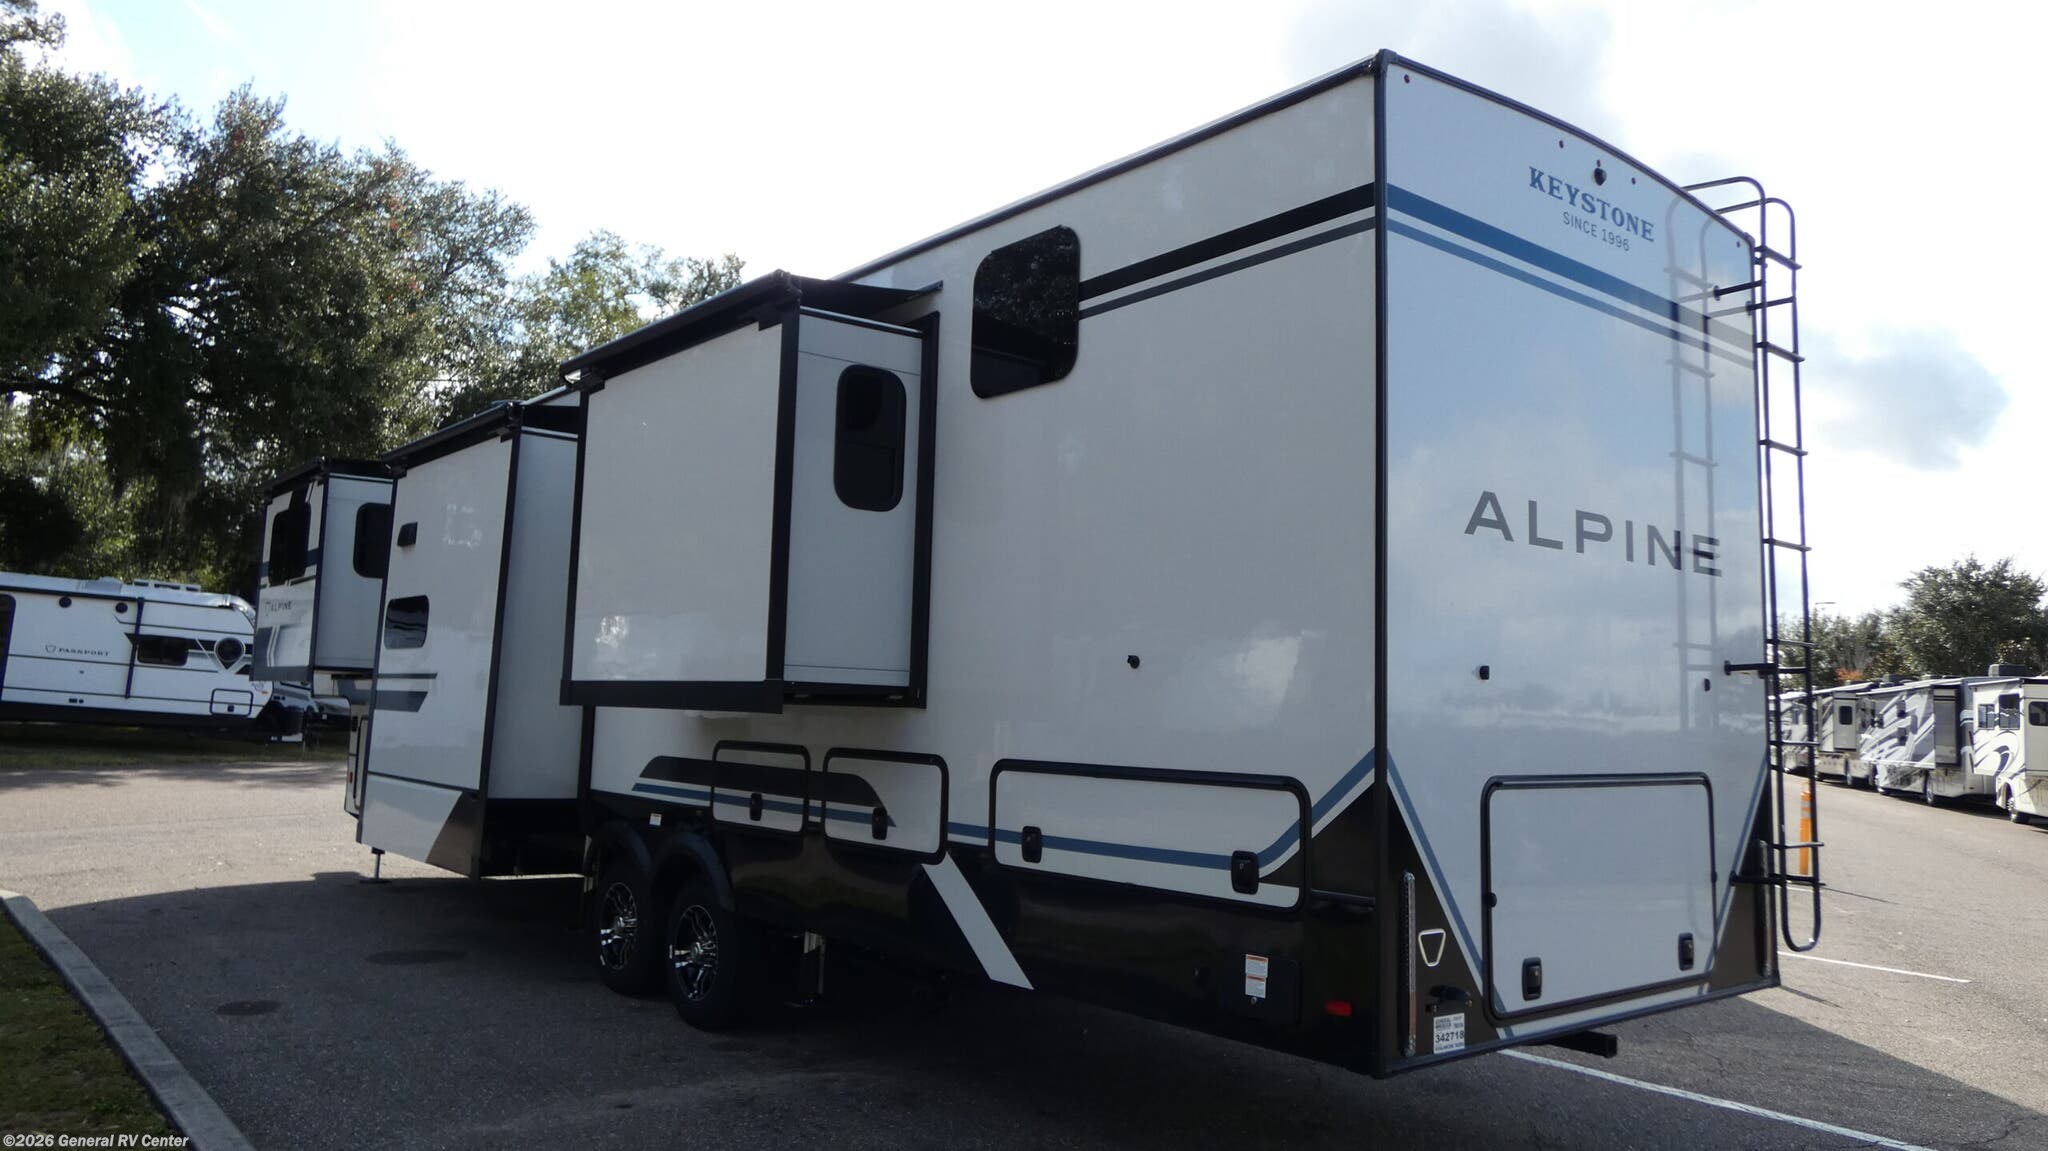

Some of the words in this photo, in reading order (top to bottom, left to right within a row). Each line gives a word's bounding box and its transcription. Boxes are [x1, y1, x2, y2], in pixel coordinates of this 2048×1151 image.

[1529, 166, 1655, 242] KEYSTONE
[1563, 211, 1597, 238] SINCE
[1602, 229, 1630, 252] 1996
[1464, 490, 1722, 577] ALPINE
[1435, 1030, 1465, 1043] 342718
